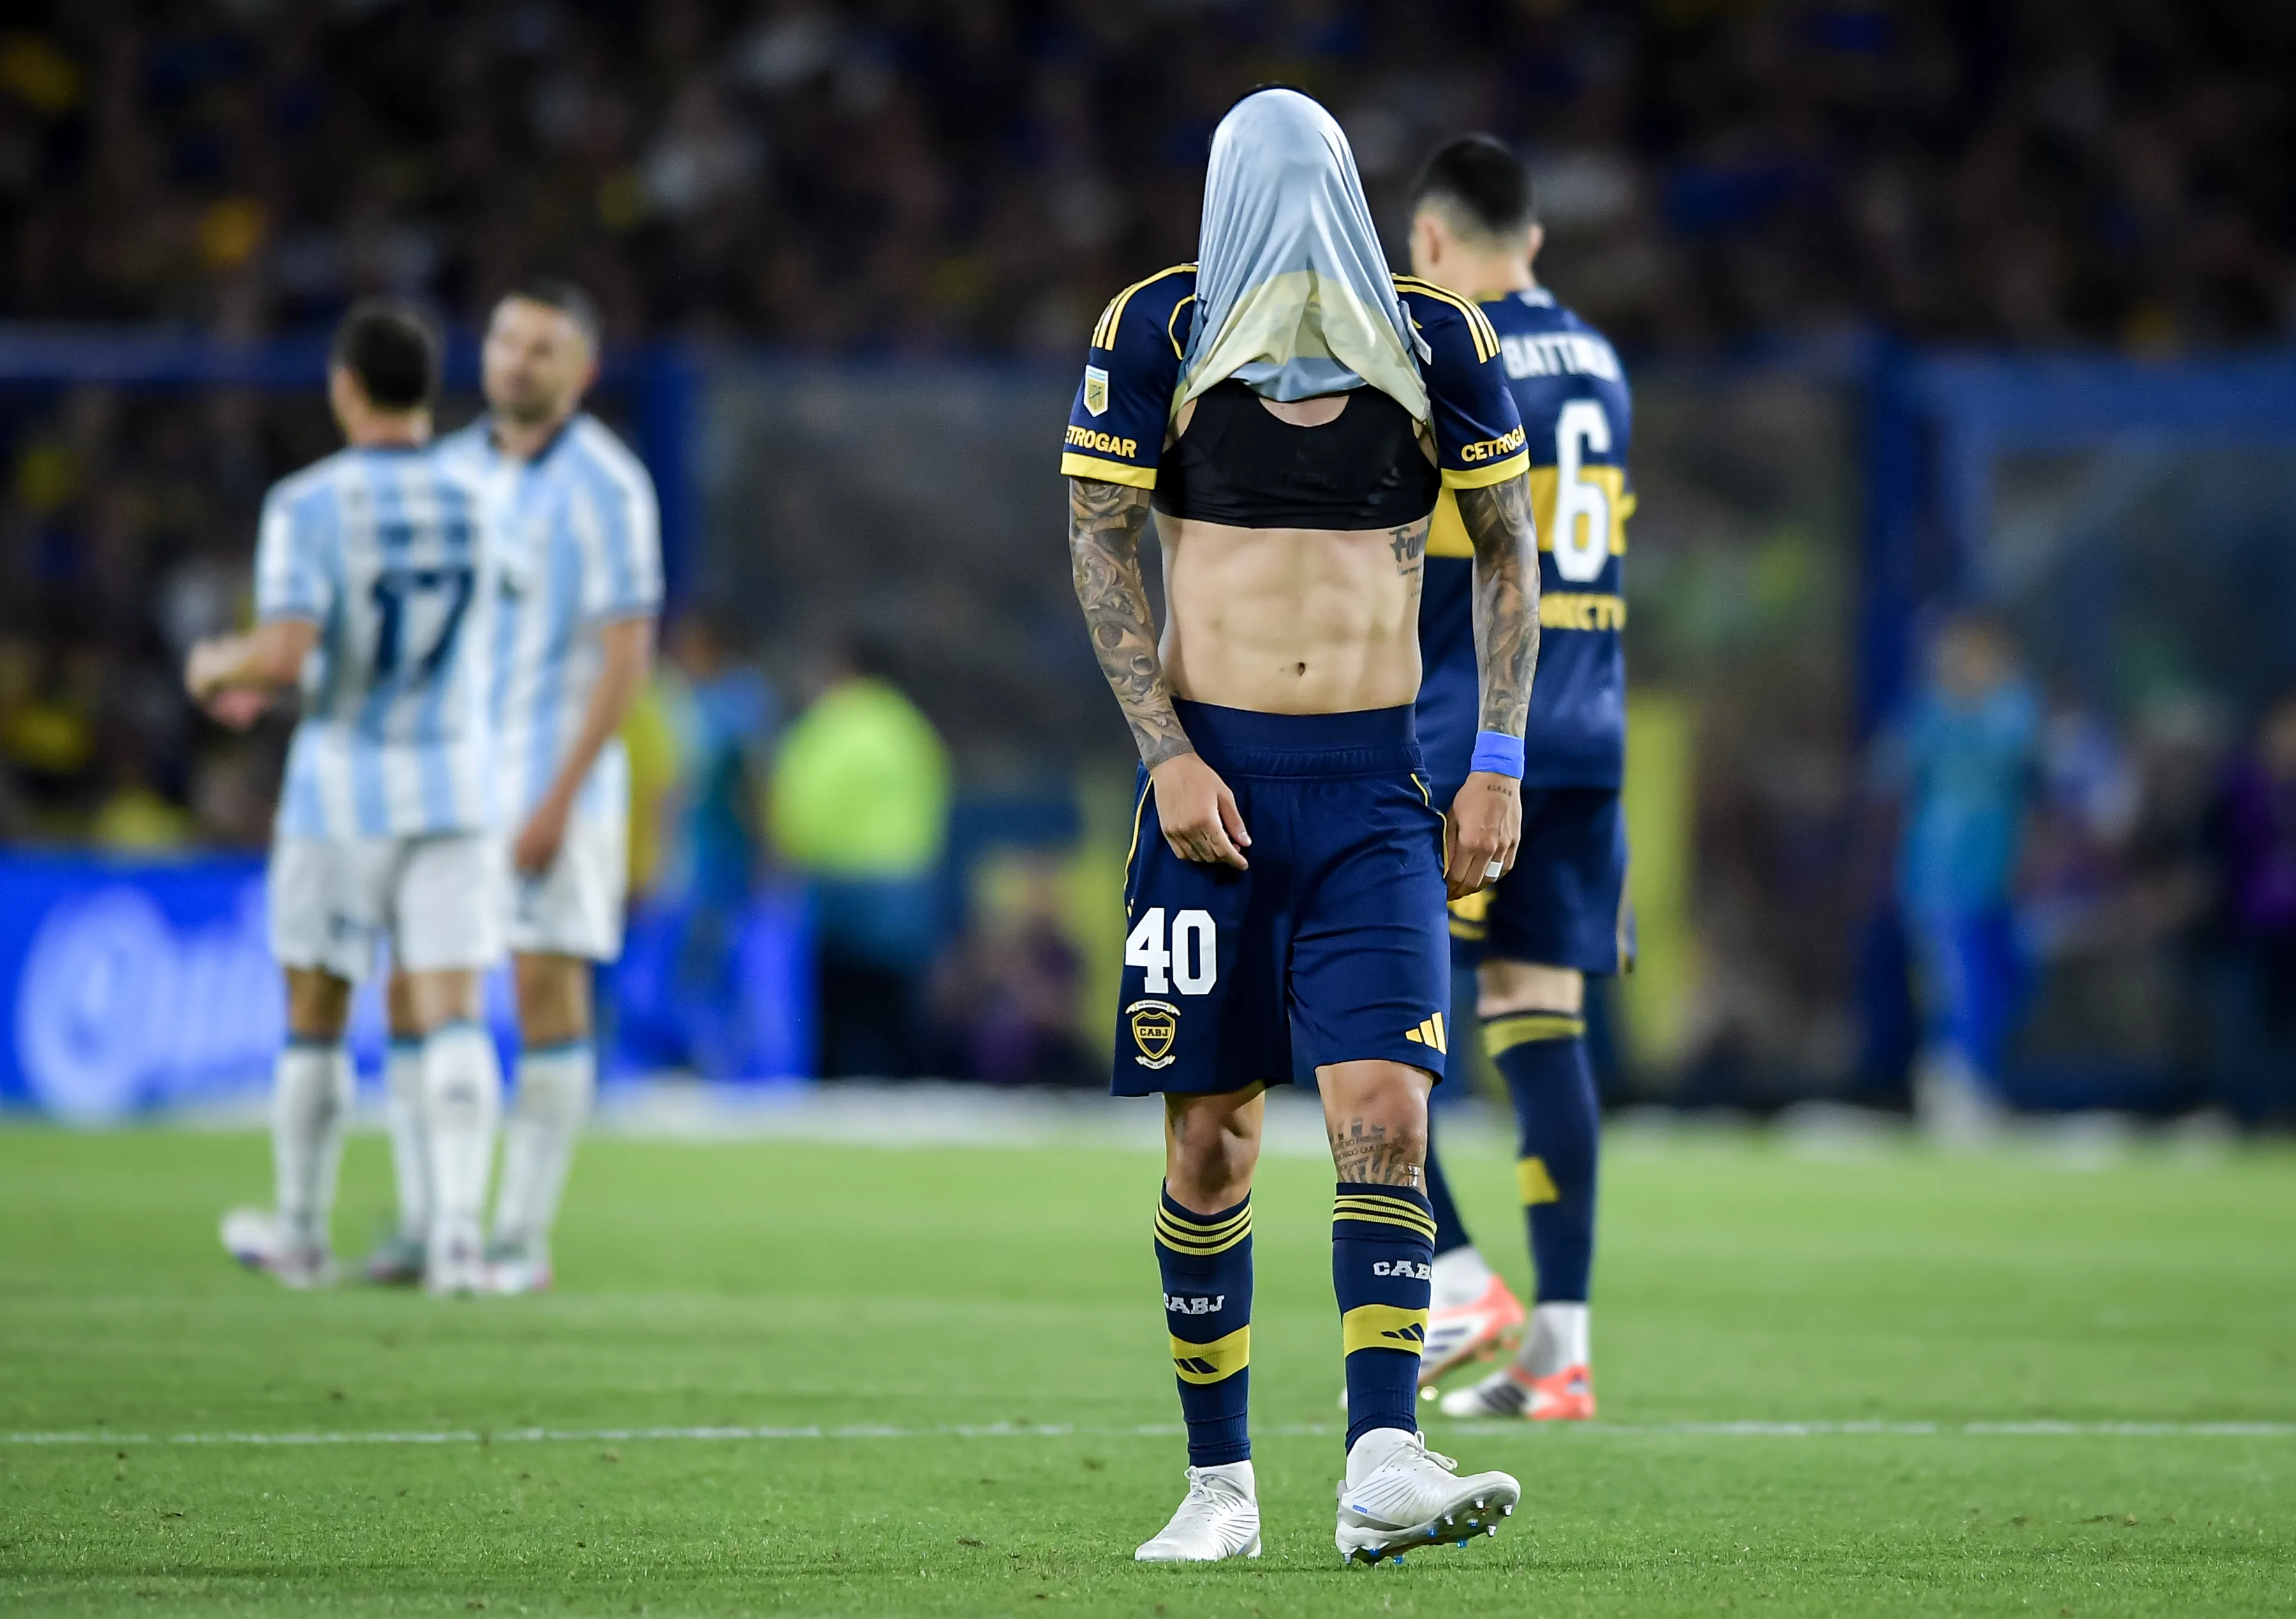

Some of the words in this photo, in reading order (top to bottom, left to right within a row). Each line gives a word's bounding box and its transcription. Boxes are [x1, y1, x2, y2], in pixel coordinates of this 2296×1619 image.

[1555, 398, 1612, 583] 6
[370, 569, 476, 686] 17
[1125, 907, 1217, 995] 40
[1140, 1028, 1168, 1037] CABJ
